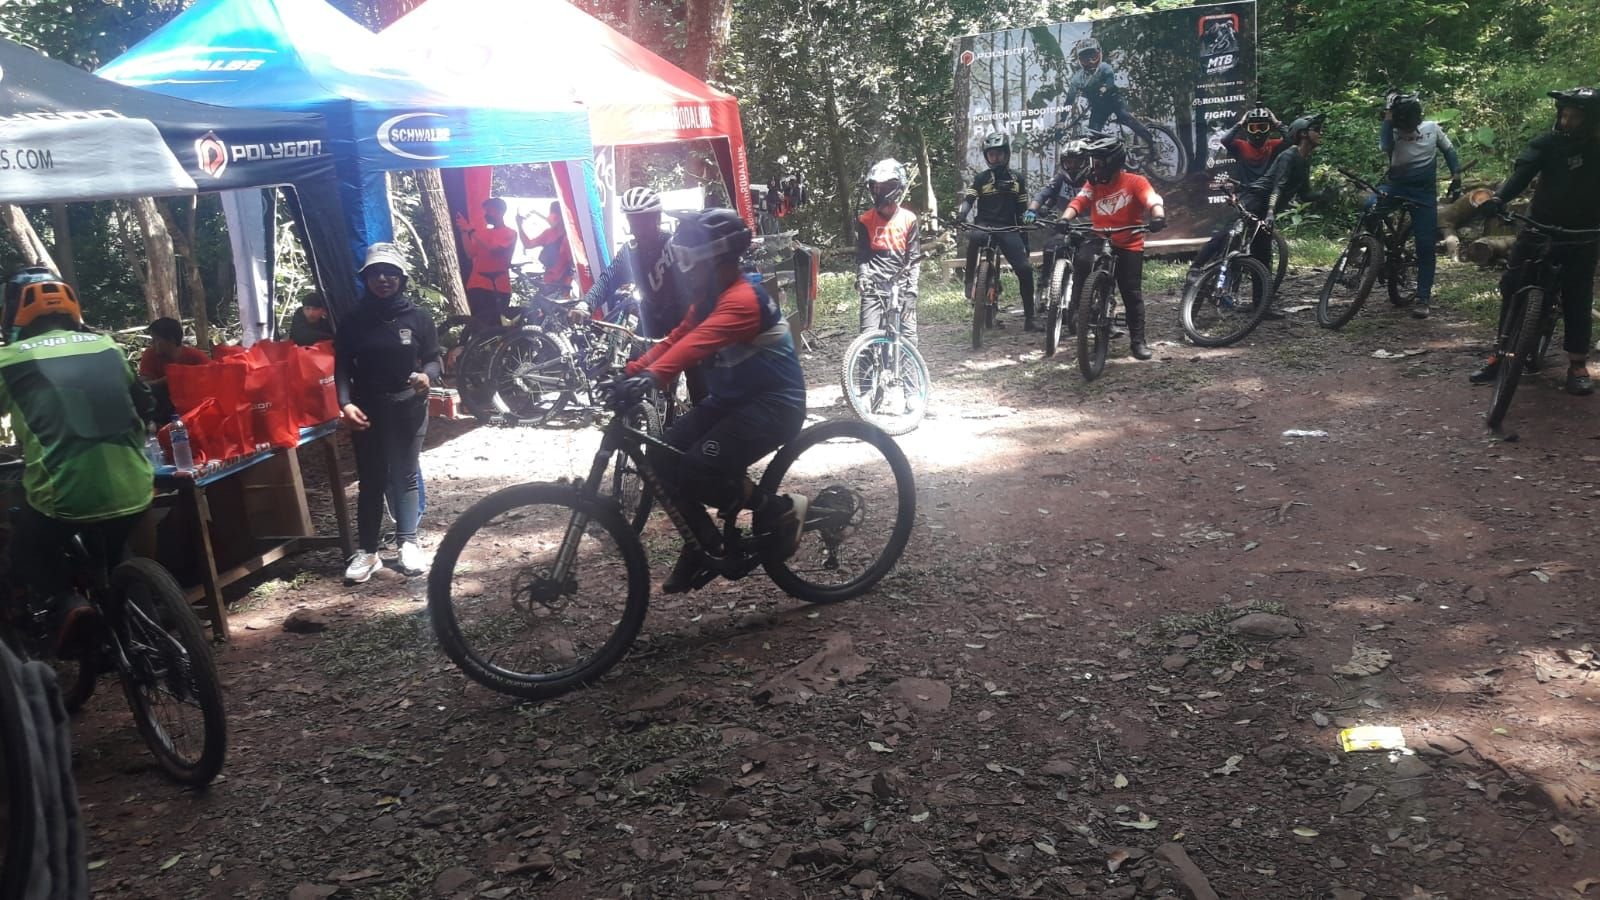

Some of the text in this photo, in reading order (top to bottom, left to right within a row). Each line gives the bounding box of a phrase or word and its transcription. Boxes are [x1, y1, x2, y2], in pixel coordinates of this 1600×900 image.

[1207, 54, 1234, 68] MTB
[1202, 94, 1245, 104] RODALINK
[973, 105, 1072, 122] POLYGON MTB BOOTCAMP
[0, 149, 54, 170] S.COM
[231, 140, 322, 162] POLYGON
